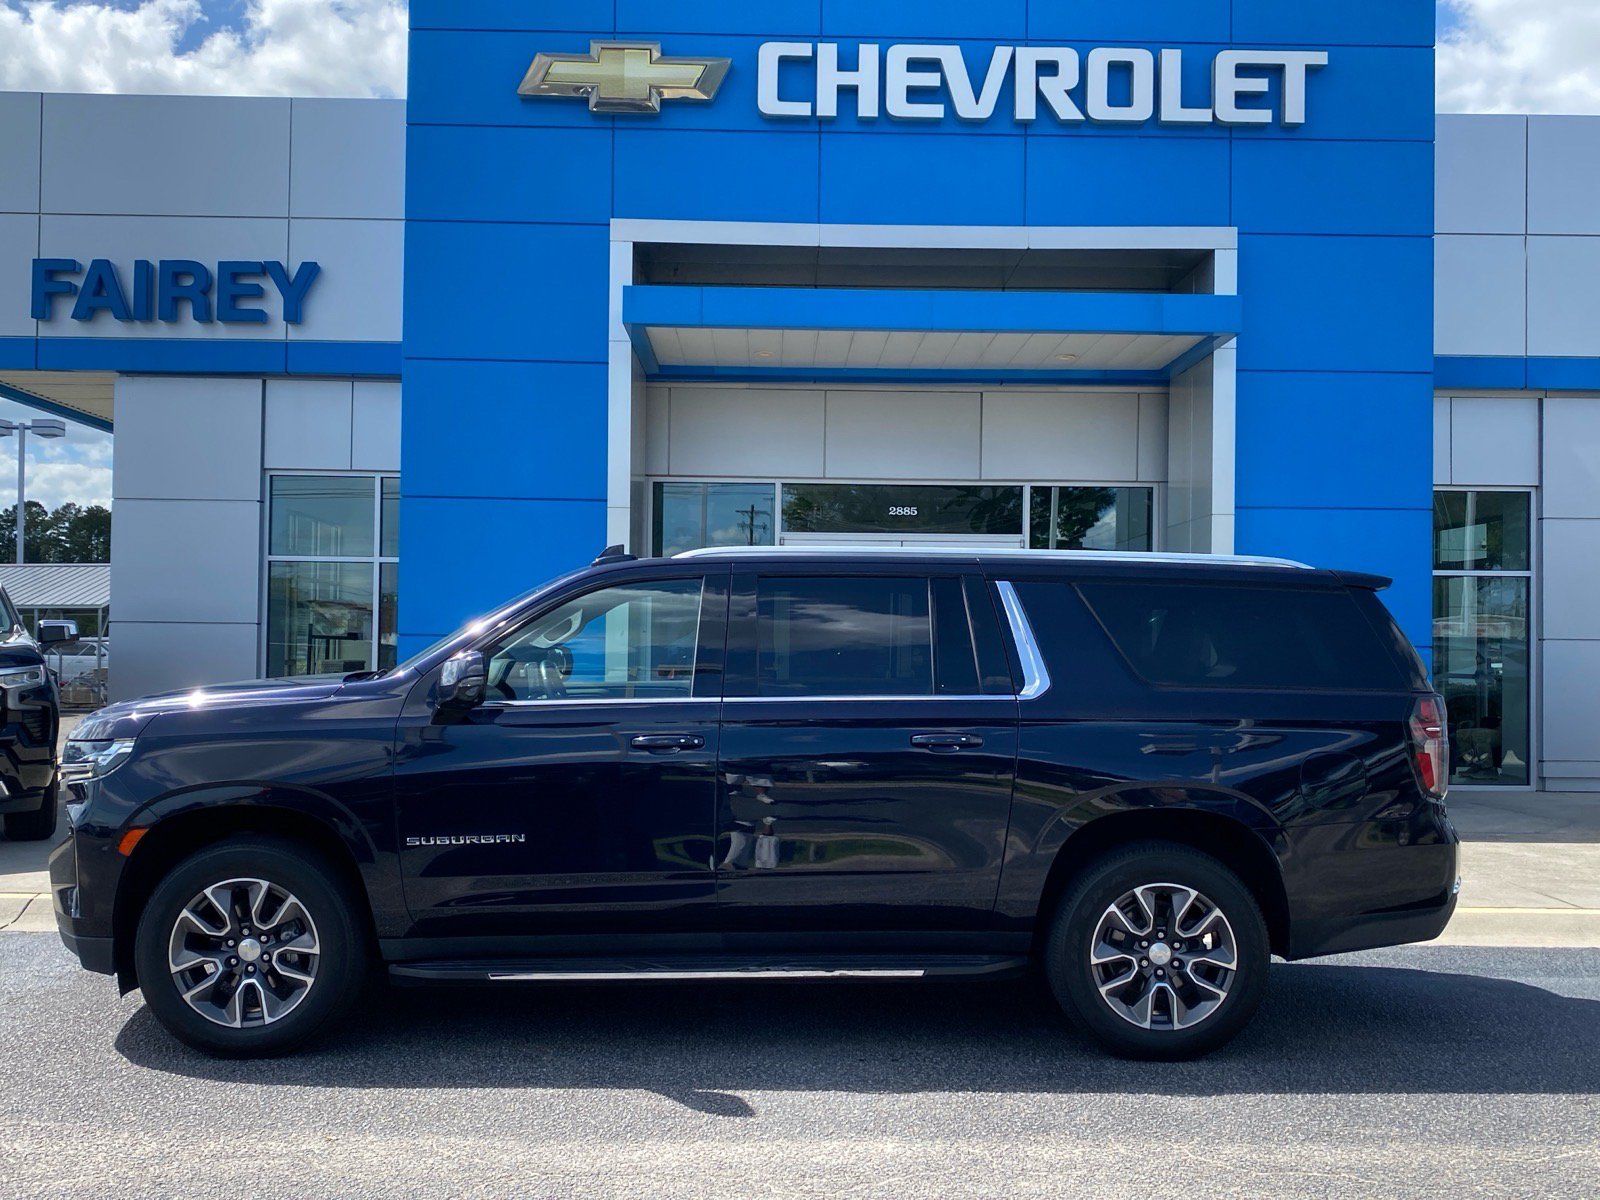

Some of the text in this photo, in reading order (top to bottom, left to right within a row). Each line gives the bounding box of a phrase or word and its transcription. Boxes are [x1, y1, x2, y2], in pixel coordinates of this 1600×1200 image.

[757, 41, 1329, 126] CHEVROLET
[31, 258, 321, 325] FAIREY
[888, 506, 918, 516] 2885
[406, 833, 526, 846] SUBURBAN
